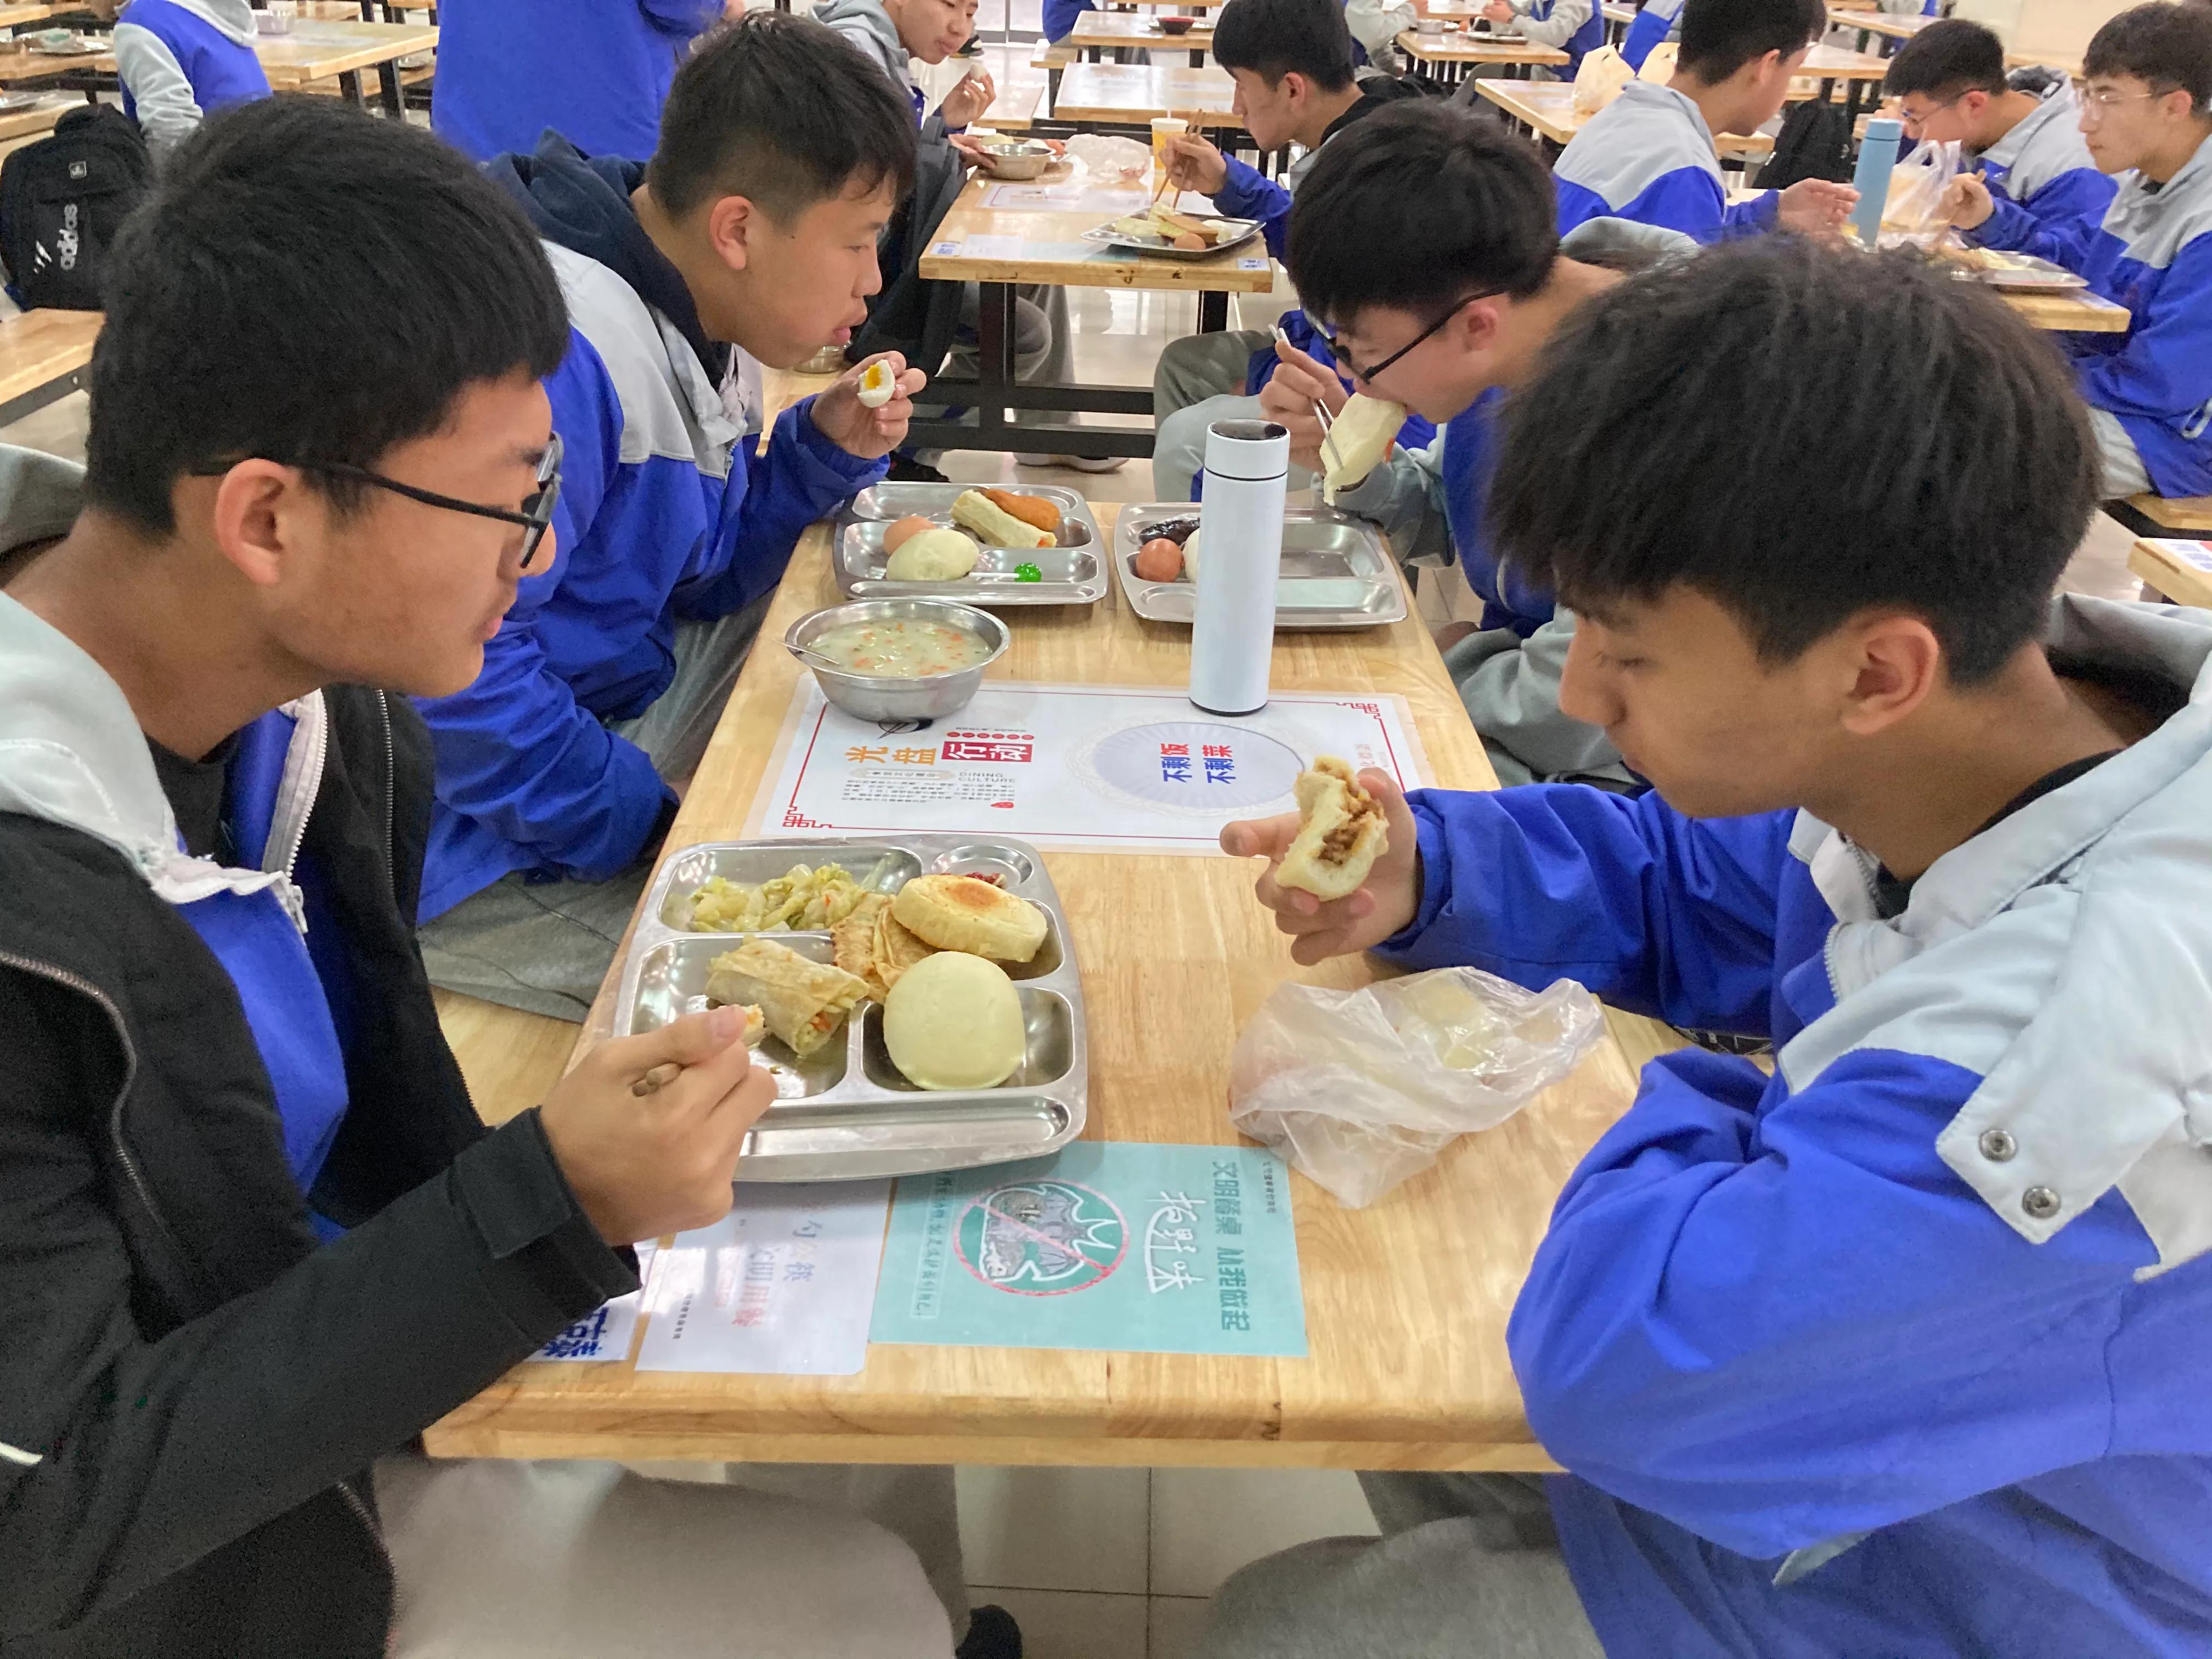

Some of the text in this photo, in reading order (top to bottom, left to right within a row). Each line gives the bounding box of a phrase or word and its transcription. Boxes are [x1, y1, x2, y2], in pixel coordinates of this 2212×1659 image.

[57, 203, 78, 270] adidas
[843, 743, 1029, 766] 光盘行动
[1160, 743, 1193, 783] 不剩饭
[1201, 744, 1237, 785] 不剩菜
[1211, 1160, 1250, 1331] 文明餐桌 从我做起
